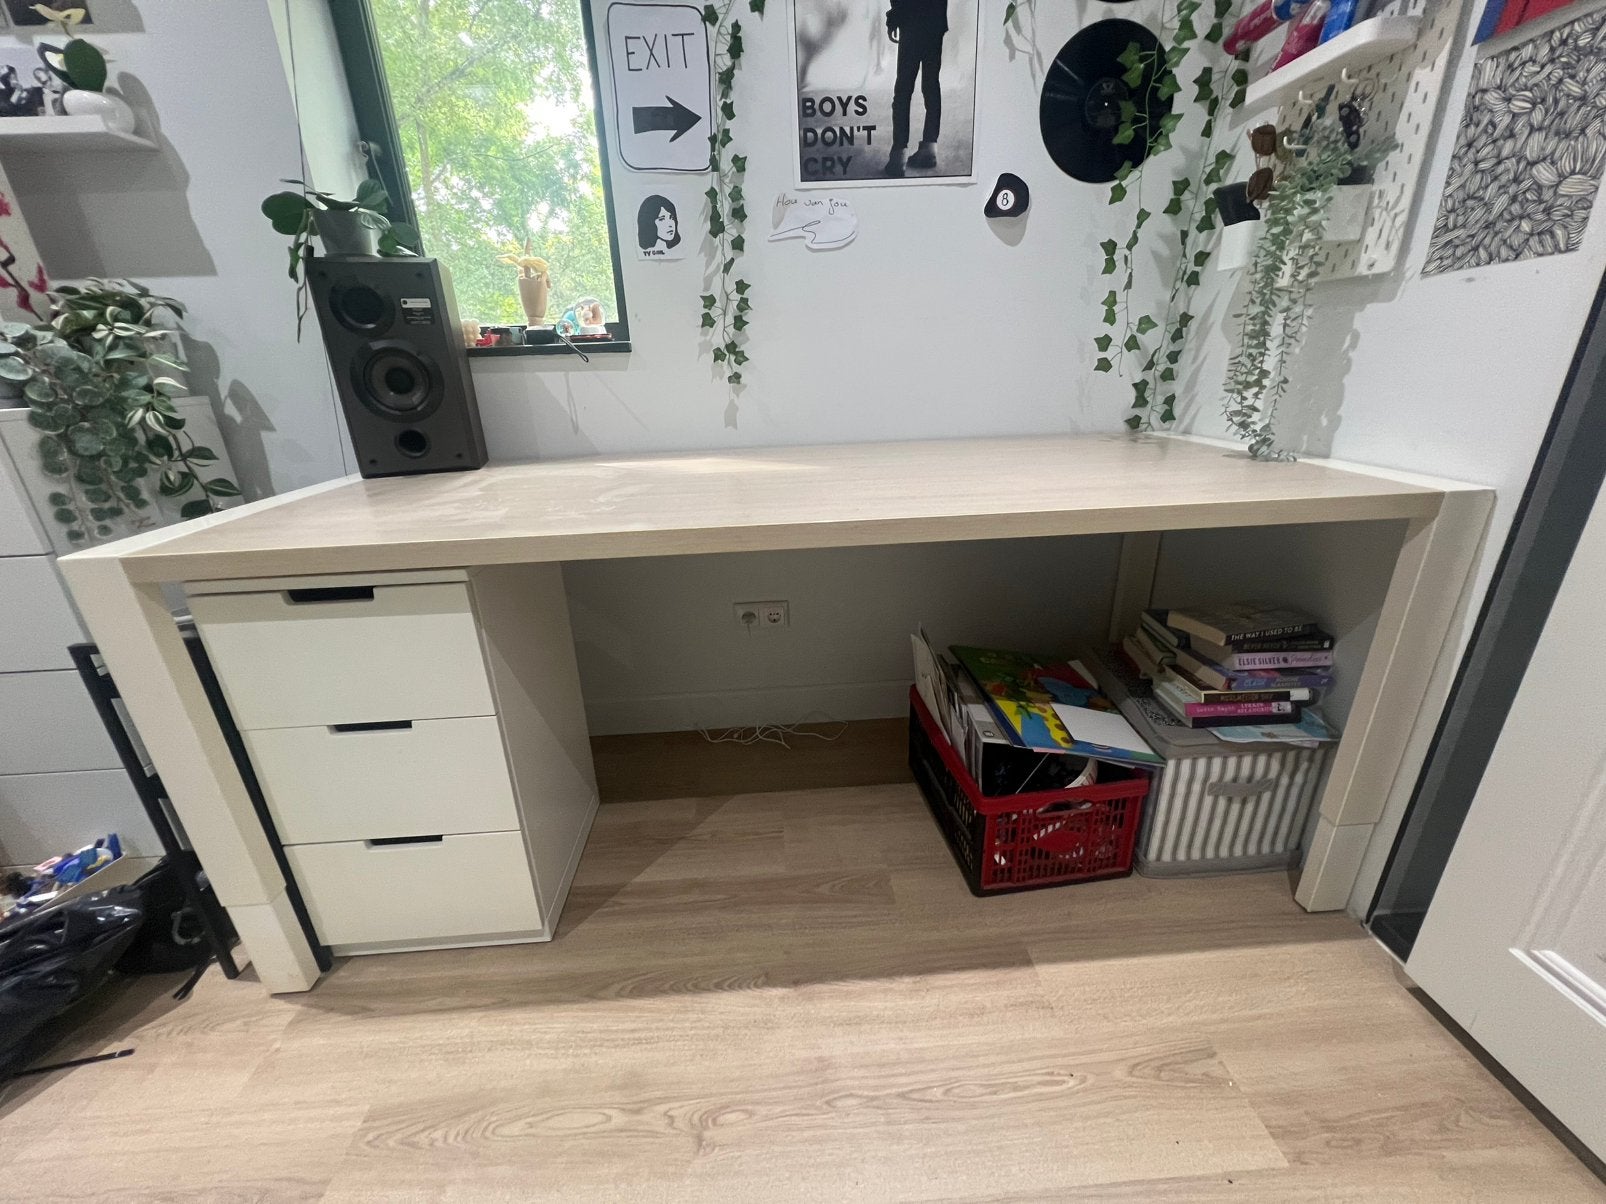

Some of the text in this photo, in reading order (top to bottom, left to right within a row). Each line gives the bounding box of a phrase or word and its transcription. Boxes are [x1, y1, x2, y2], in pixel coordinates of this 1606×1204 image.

[624, 33, 695, 71] EXIT
[802, 95, 867, 118] BOYS
[803, 125, 876, 147] DON'T
[803, 156, 852, 176] CRY
[1001, 192, 1009, 206] 8
[1231, 632, 1244, 641] THE
[1245, 631, 1259, 639] WAY
[1265, 628, 1283, 636] USED
[1238, 657, 1258, 666] ELSIE
[1259, 656, 1280, 665] SILVER
